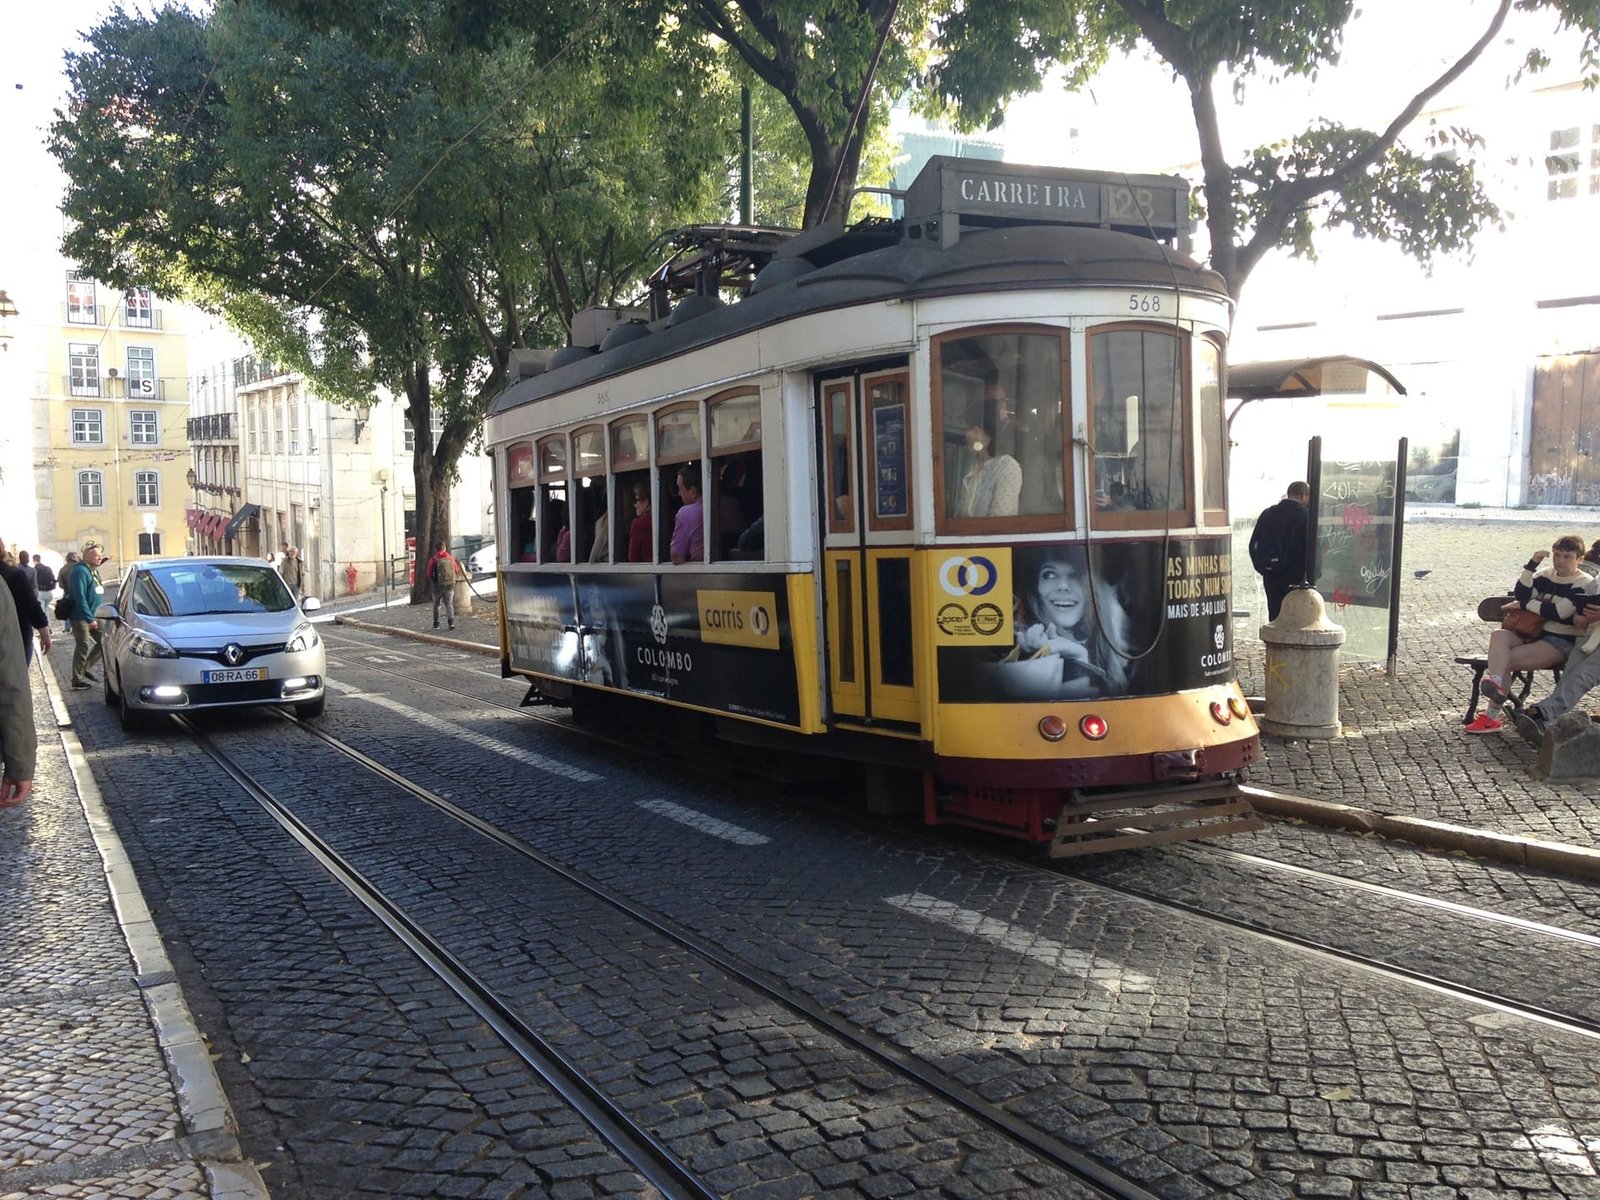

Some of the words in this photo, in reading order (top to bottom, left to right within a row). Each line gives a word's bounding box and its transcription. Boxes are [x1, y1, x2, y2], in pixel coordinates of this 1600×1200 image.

[961, 179, 1086, 208] CARREIRA
[1129, 294, 1161, 312] 568
[142, 380, 152, 392] S
[1167, 557, 1182, 577] AS
[1186, 555, 1218, 575] MINHAS
[1167, 578, 1201, 599] TODAS
[1204, 577, 1220, 596] NUM
[705, 602, 743, 630] carris
[1168, 604, 1188, 619] MAIS
[1190, 603, 1200, 617] DE
[1201, 602, 1213, 616] 340
[637, 647, 692, 672] COLOMBO
[211, 670, 258, 682] 08-RA-66
